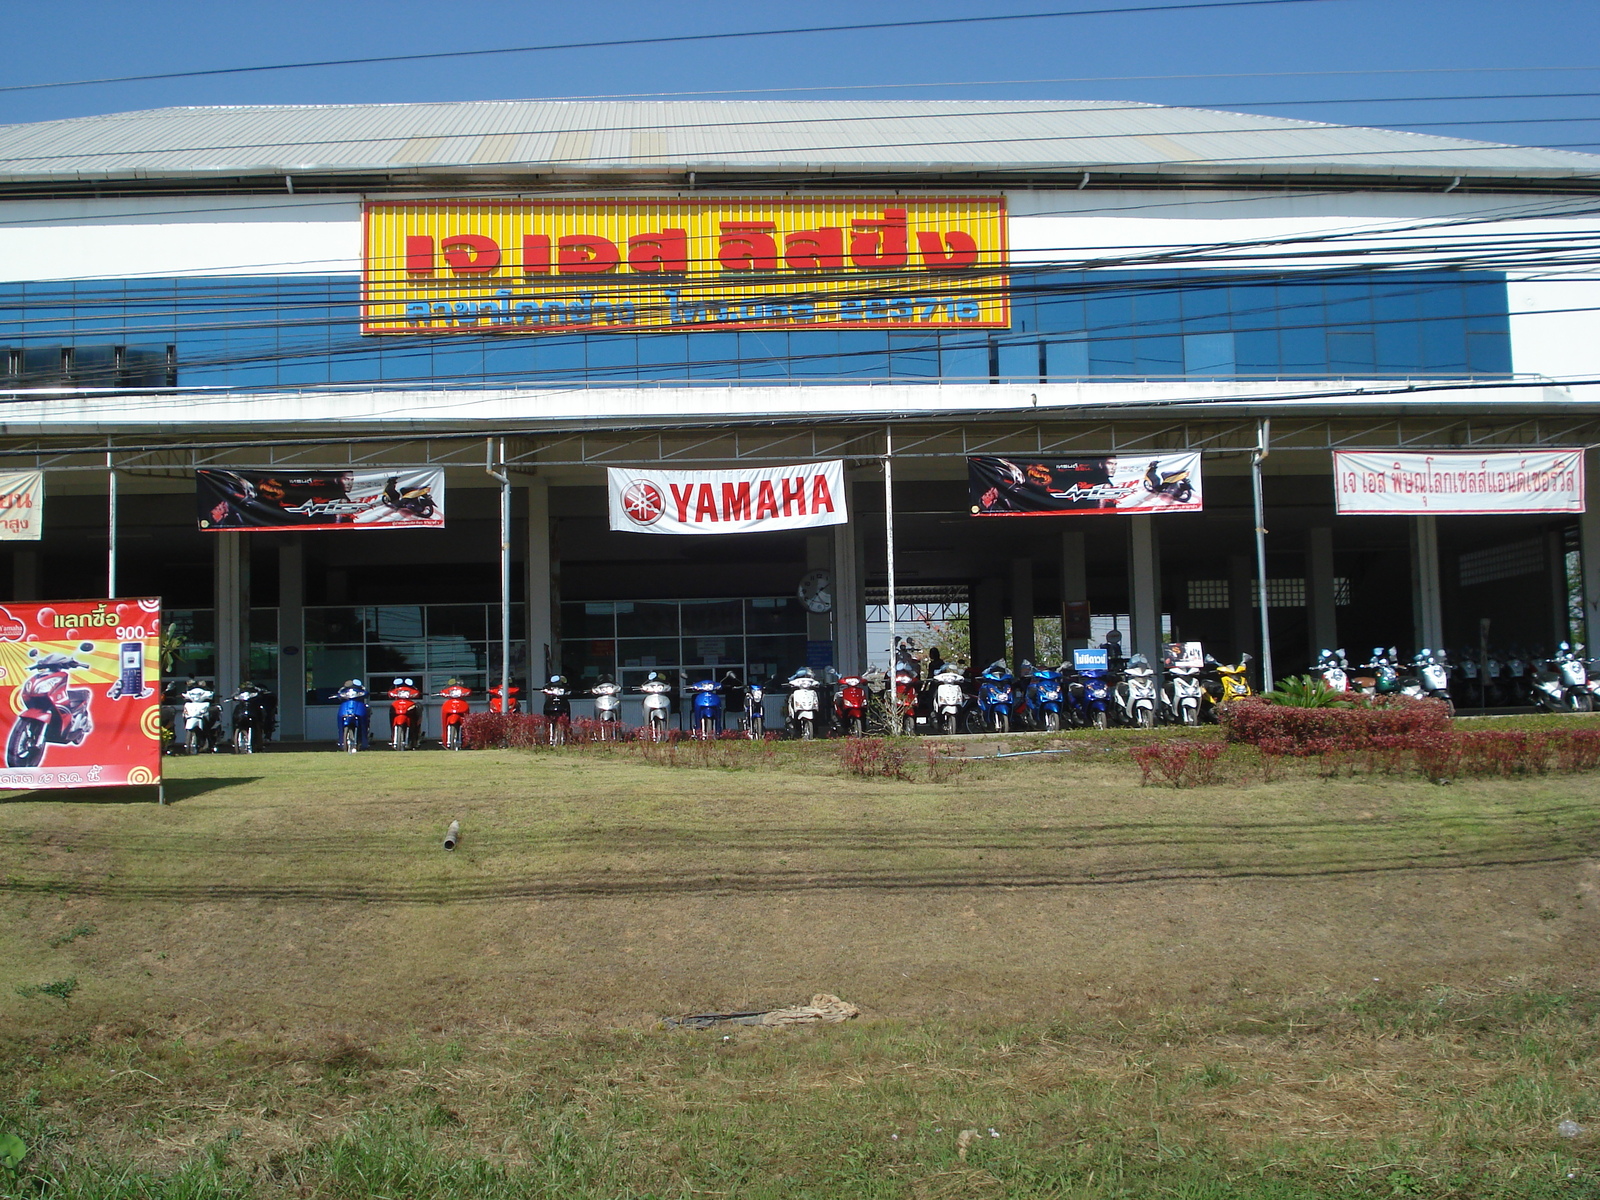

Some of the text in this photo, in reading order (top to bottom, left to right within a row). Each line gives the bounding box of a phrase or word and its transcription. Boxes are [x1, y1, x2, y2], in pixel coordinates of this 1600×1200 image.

[523, 228, 687, 273] เอส
[669, 474, 834, 522] YAMAHA
[1343, 472, 1356, 493] เจ
[1363, 471, 1386, 493] เอส
[54, 603, 120, 628] แลกซื้อ
